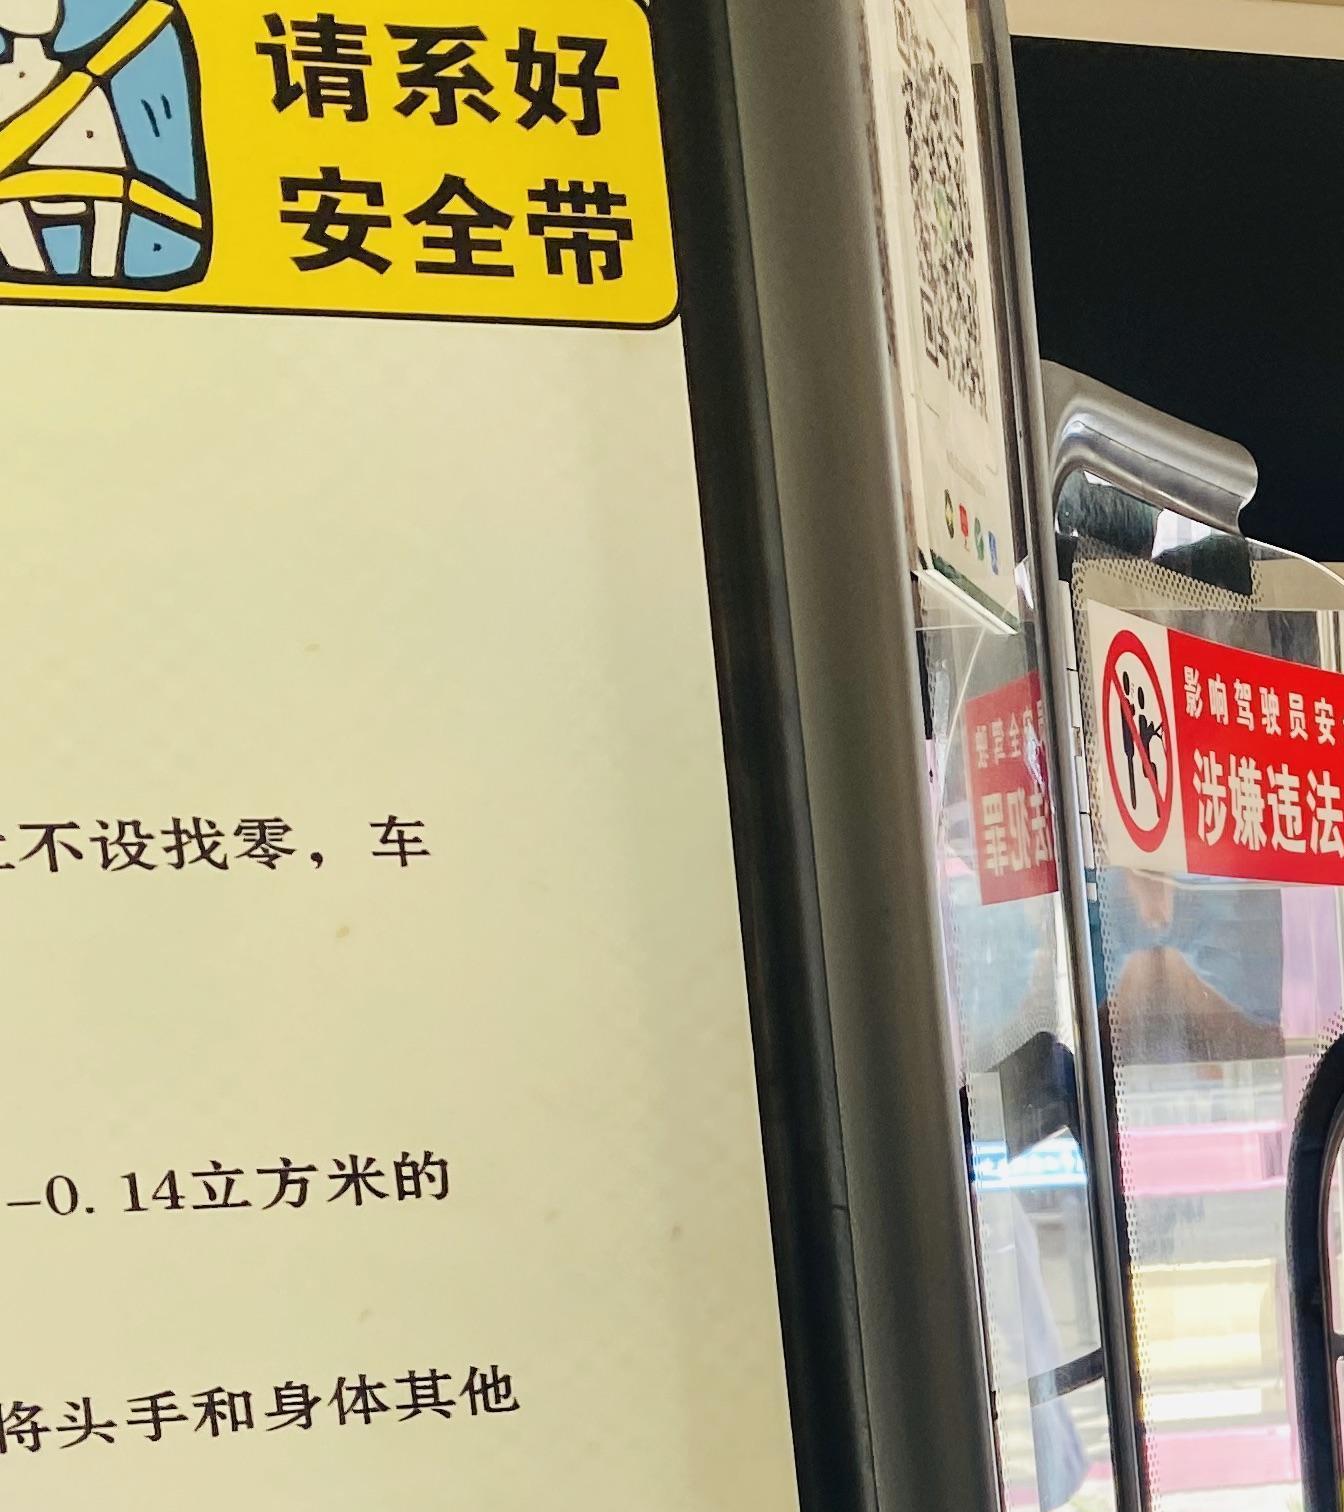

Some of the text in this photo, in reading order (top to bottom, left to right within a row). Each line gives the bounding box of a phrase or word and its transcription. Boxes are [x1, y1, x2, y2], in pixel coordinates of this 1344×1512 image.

[255, 13, 620, 137] 请系好
[280, 166, 634, 284] 安全带
[0, 1365, 521, 1455] 将头手和身体其他
